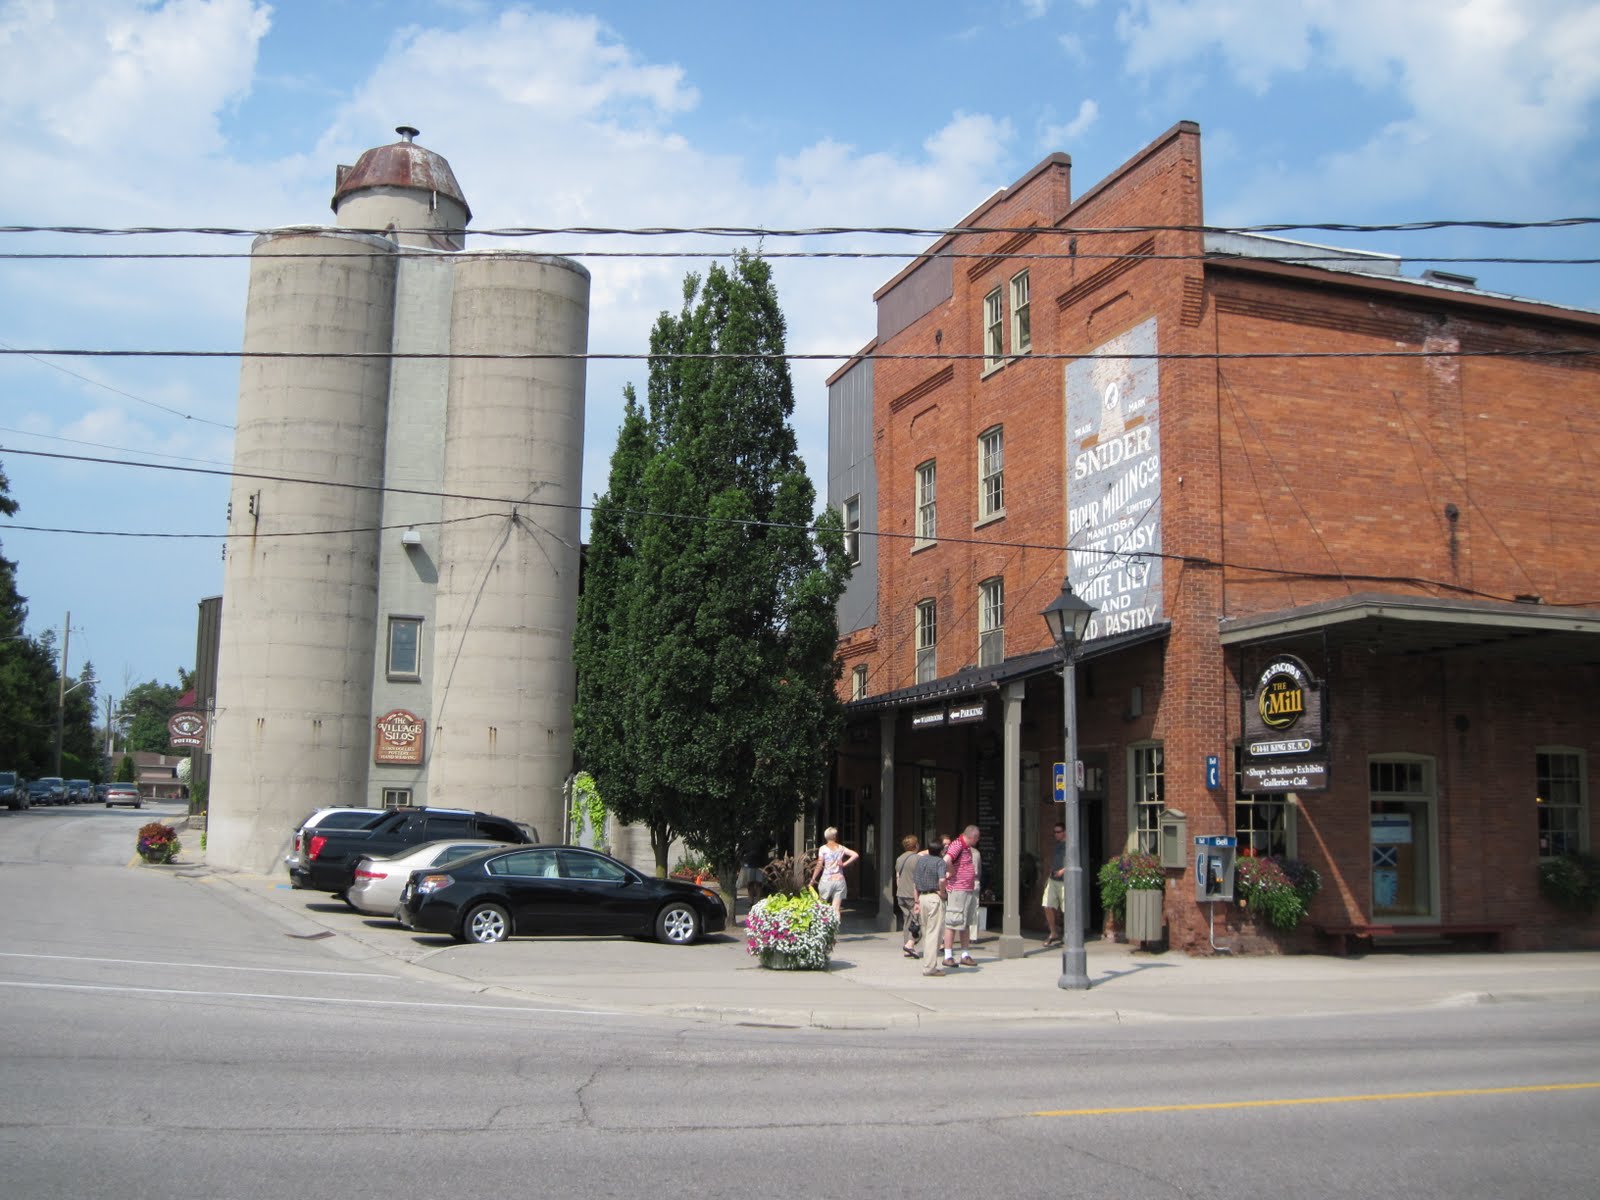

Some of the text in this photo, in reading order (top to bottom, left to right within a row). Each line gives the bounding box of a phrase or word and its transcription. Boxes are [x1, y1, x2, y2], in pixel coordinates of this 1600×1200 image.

[1128, 396, 1146, 413] MARK
[1075, 422, 1092, 438] TRADE
[1075, 426, 1152, 480] SNIDER
[1069, 501, 1099, 535] FLOUR
[1102, 461, 1147, 522] MILLING
[1126, 497, 1152, 515] LIMITED
[1086, 517, 1135, 542] MANITOBA
[1072, 522, 1156, 569] WHITE DAISY
[1075, 562, 1151, 602] WHITE LILY
[1100, 594, 1131, 614] AND
[1105, 603, 1157, 636] PASTRY
[1270, 662, 1301, 680] JACOBS
[1273, 682, 1288, 691] THE
[1268, 688, 1303, 715] Mill
[960, 707, 984, 718] PARKING
[377, 723, 421, 734] VILLAGE
[385, 731, 415, 741] SILOS
[1270, 743, 1286, 752] KING
[1249, 764, 1324, 778] Shops Studios Exhibits
[1263, 778, 1289, 786] Galleries
[1215, 837, 1228, 846] Bell
